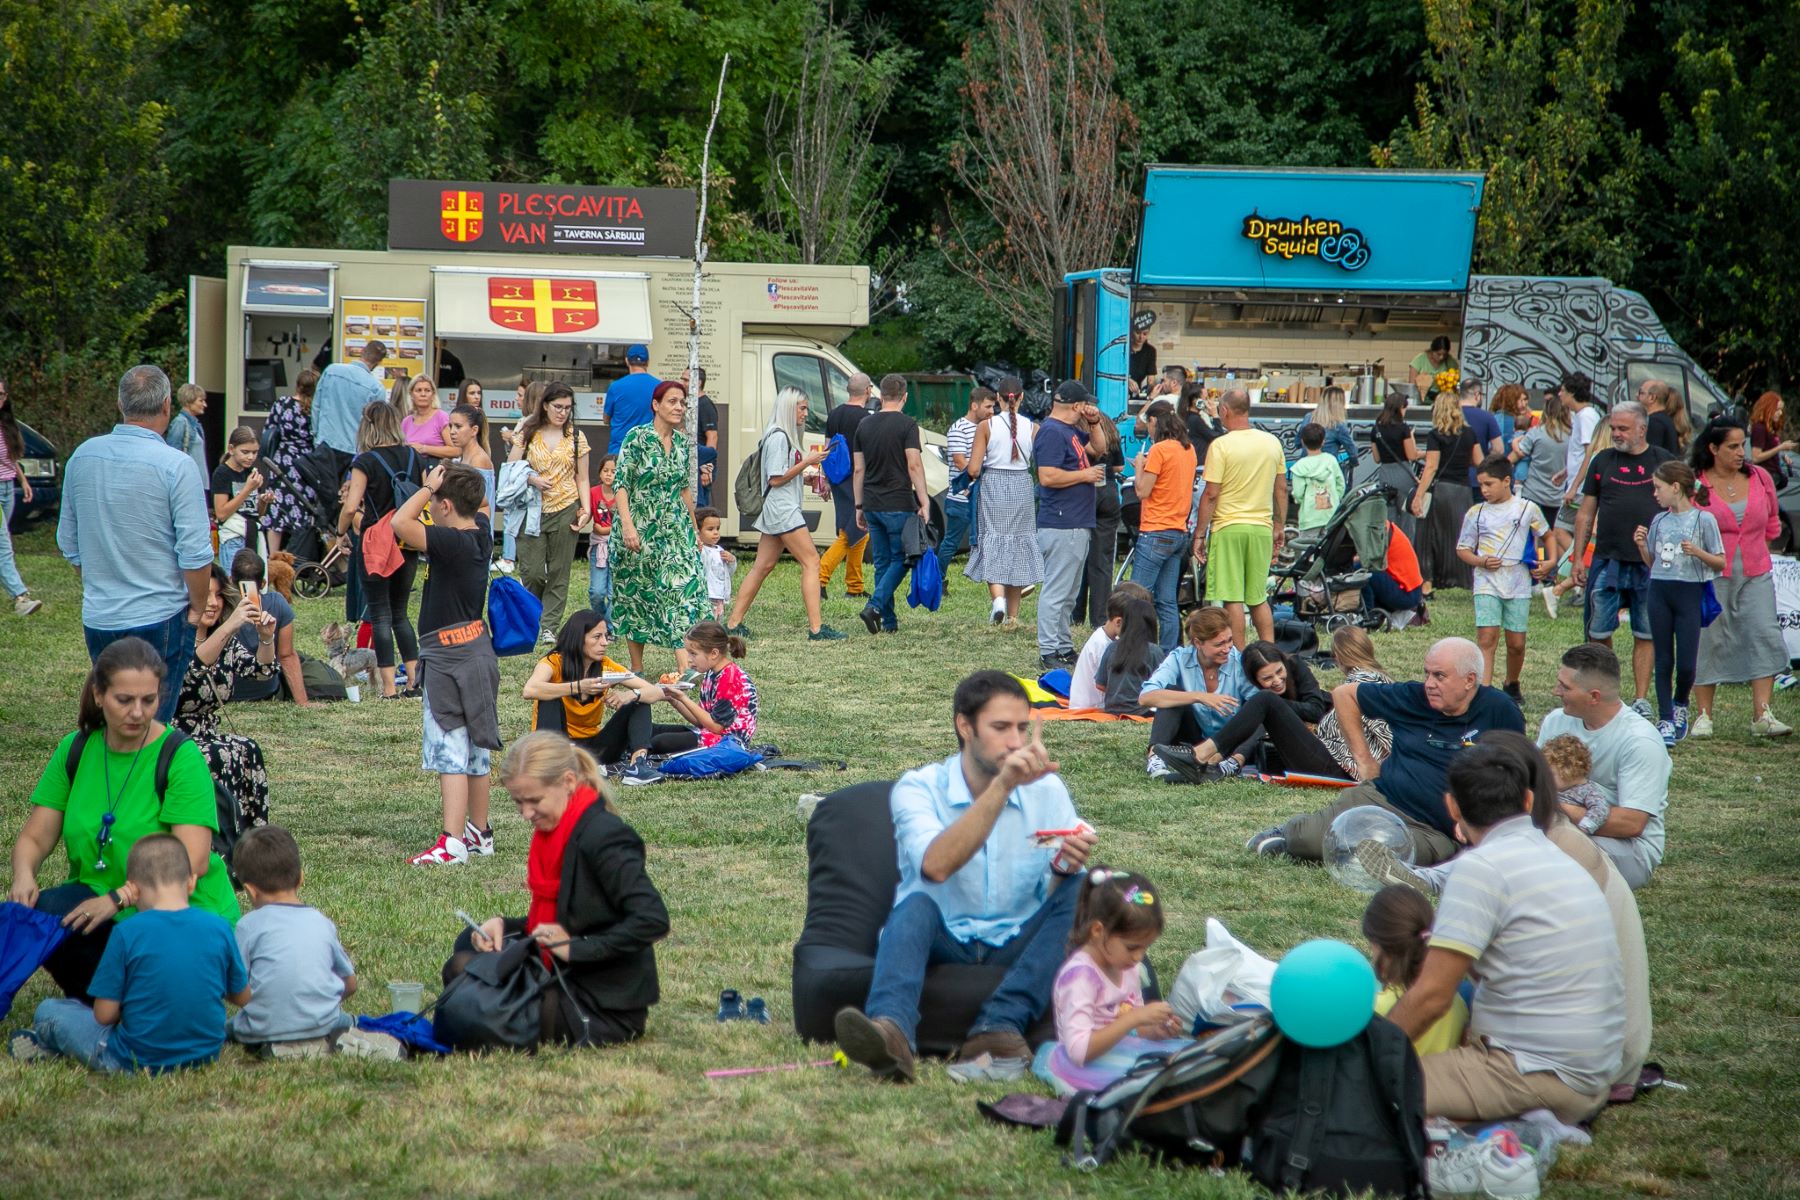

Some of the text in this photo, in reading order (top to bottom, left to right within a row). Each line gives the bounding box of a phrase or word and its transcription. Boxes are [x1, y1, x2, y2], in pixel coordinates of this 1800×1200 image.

[498, 192, 644, 224] PLEȘCAVIȚA
[500, 222, 546, 244] VAN
[564, 229, 603, 240] TAVERNA
[1248, 217, 1341, 239] Drunken
[1265, 237, 1319, 260] Squid
